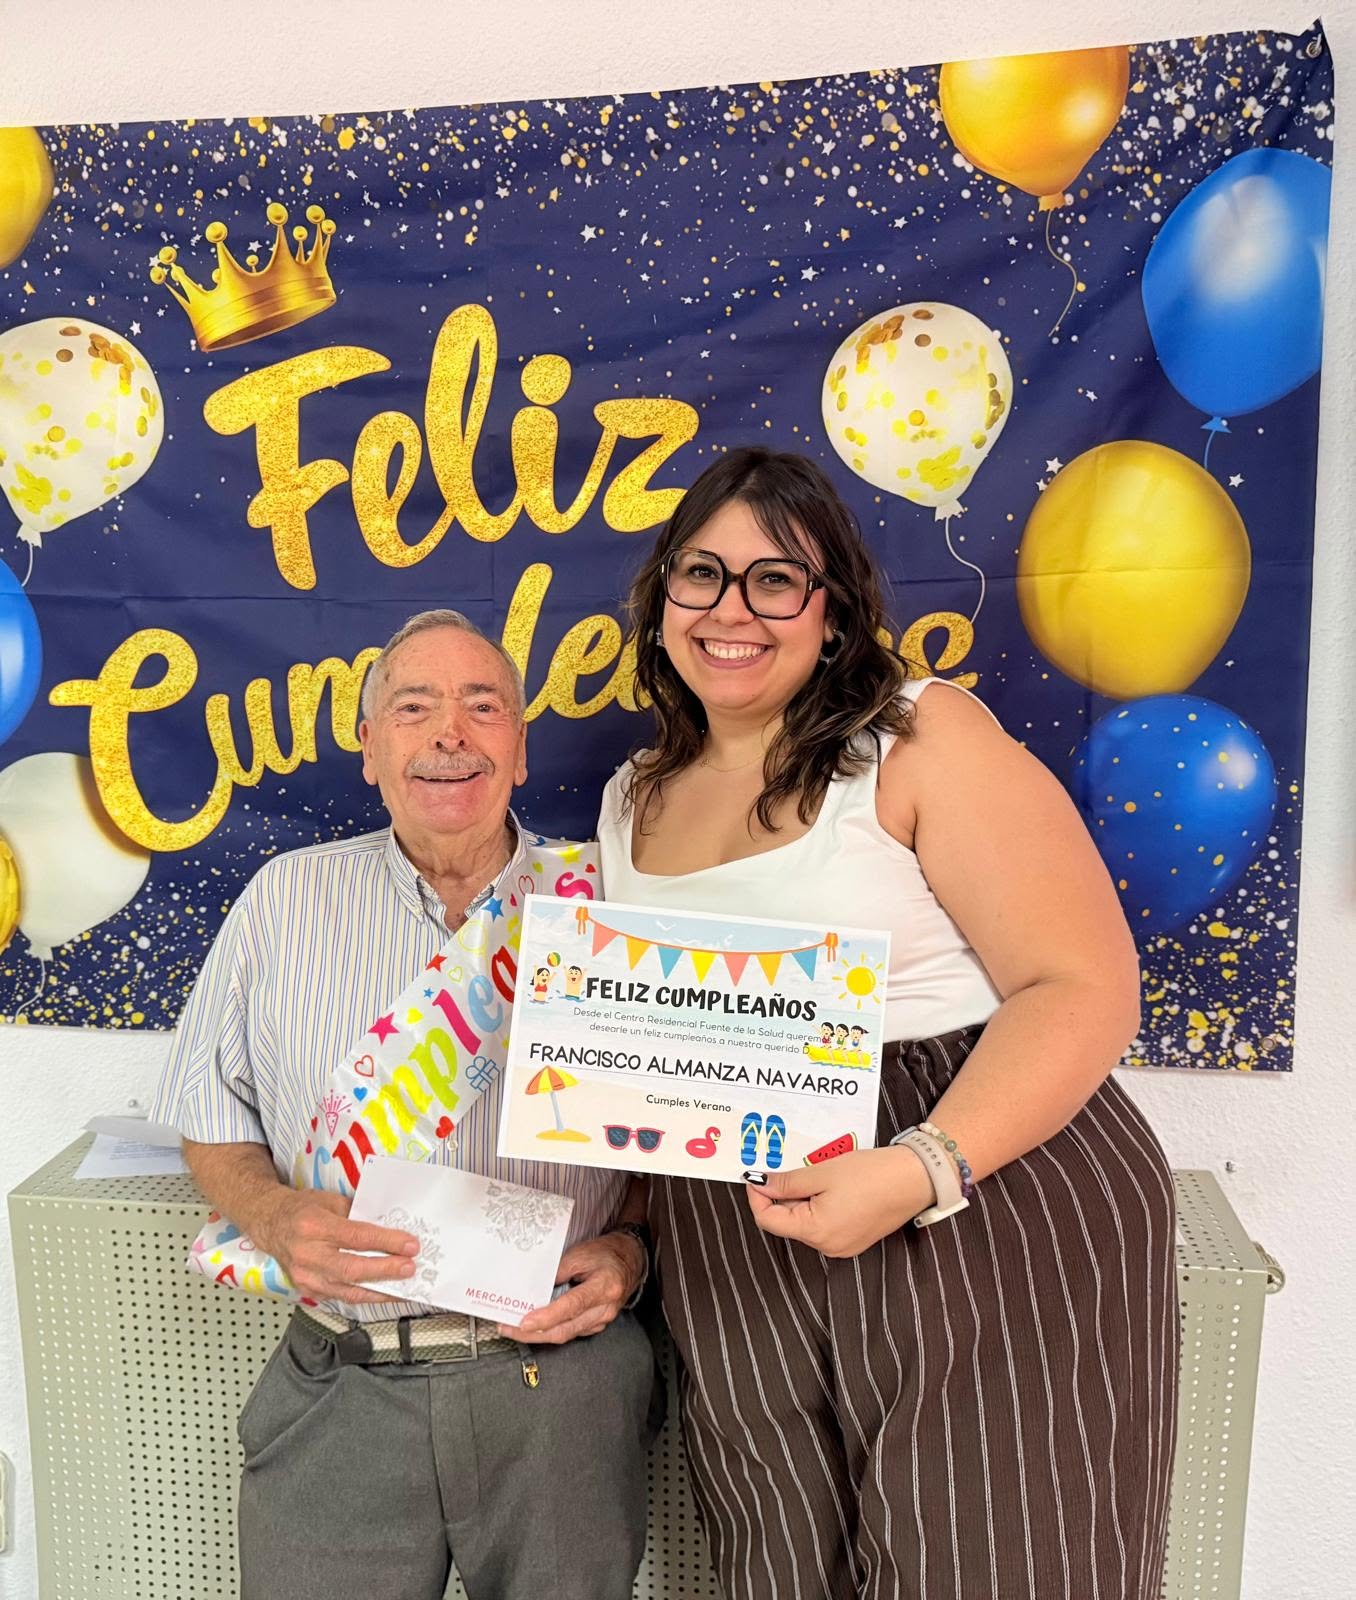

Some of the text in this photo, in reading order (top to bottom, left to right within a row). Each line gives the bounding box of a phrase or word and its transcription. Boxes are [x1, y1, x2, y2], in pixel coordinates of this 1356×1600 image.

[203, 303, 700, 591] Feliz
[586, 976, 817, 1022] FELIZ CUMPLEAÑOS
[573, 1007, 602, 1018] Desde
[604, 1009, 612, 1019] el
[614, 1011, 645, 1023] Centro
[647, 1015, 697, 1029] Residencial
[700, 1021, 731, 1033] Fuente
[733, 1023, 745, 1034] de
[747, 1025, 756, 1035] la
[758, 1027, 784, 1039] Salud
[589, 1022, 628, 1035] desearle
[630, 1028, 641, 1036] un
[643, 1027, 661, 1038] feliz
[663, 1031, 717, 1045] cumpleaños
[727, 1038, 762, 1050] nuestra
[764, 1042, 800, 1054] querido
[529, 1042, 859, 1096] FRANCISCO ALMANZA NAVARRO
[646, 1094, 732, 1113] Cumples Verano
[465, 1287, 536, 1311] MERCADONA
